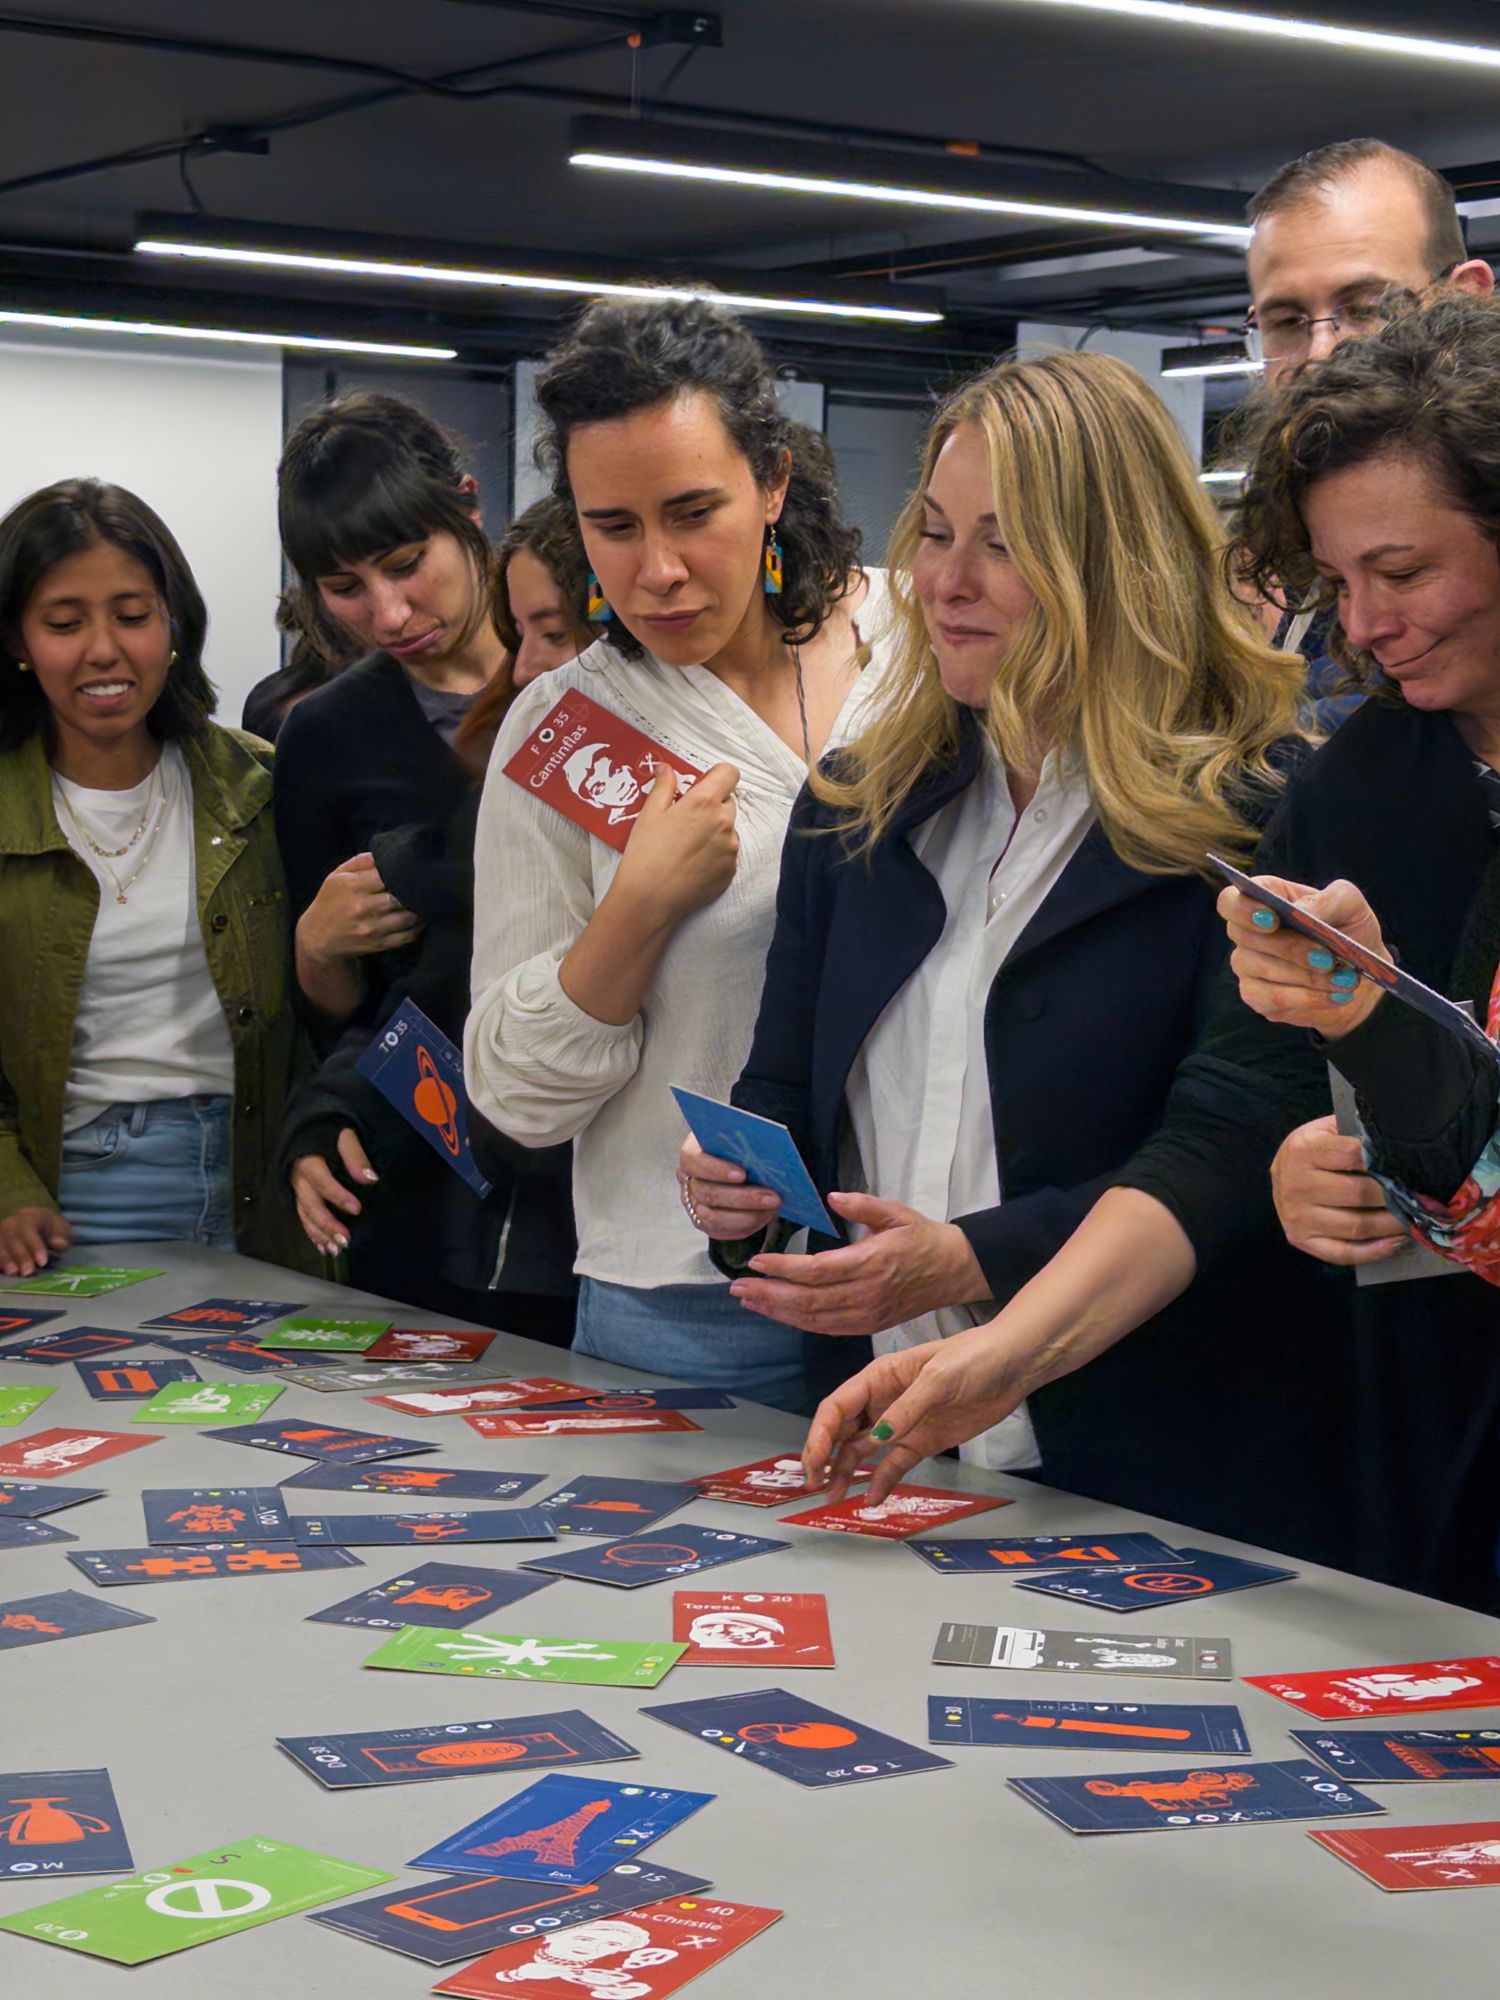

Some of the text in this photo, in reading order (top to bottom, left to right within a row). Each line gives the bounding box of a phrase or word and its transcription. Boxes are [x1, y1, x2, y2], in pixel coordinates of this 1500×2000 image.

[530, 710, 571, 756] F 35
[529, 724, 589, 789] Cantinflas
[378, 1043, 389, 1053] T
[683, 1603, 741, 1611] Teresa
[1322, 1691, 1374, 1713] Spock
[825, 1761, 901, 1778] T 20
[647, 1790, 672, 1800] 15
[641, 1872, 667, 1883] 15
[705, 1905, 733, 1917] 40
[651, 1909, 723, 1932] Christie
